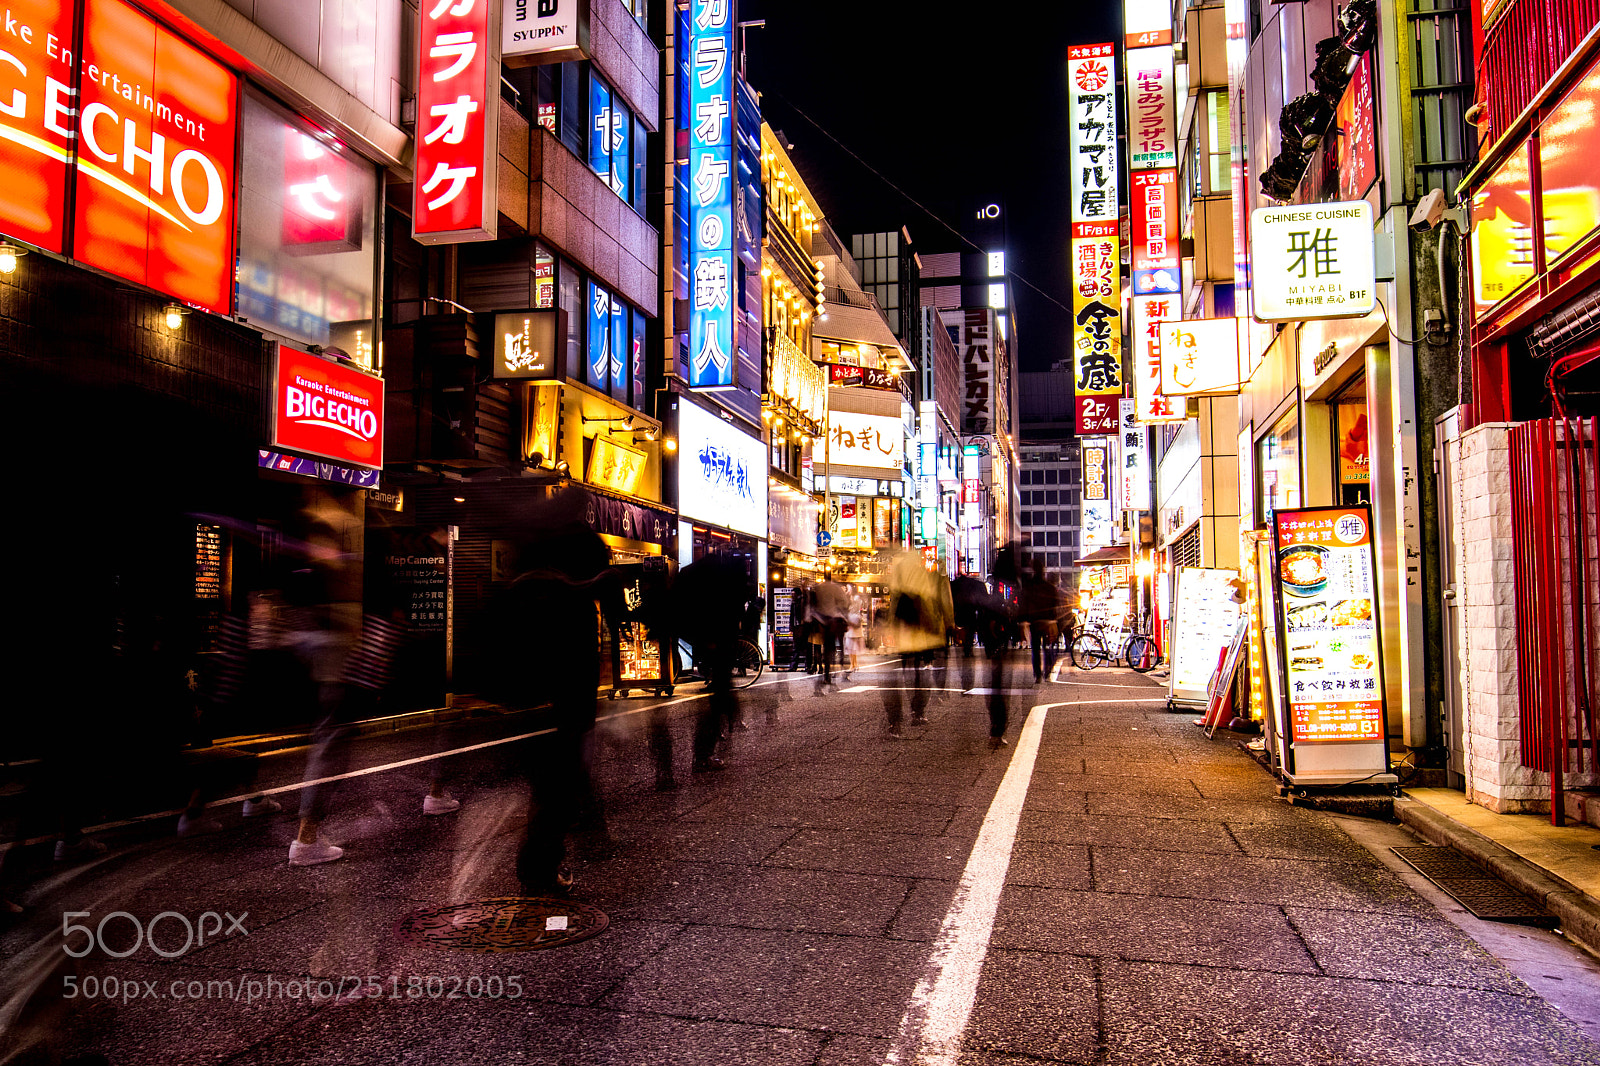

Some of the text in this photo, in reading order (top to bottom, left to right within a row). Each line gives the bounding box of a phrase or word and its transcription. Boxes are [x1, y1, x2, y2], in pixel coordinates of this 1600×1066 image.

[1138, 32, 1159, 45] 4F
[1071, 45, 1112, 57] 大衆酒場
[44, 75, 224, 226] ECHO
[1077, 94, 1108, 217] アカマル屋
[1264, 208, 1361, 224] CHINESE CUISINE
[1077, 224, 1115, 236] 1F/B1F
[1079, 244, 1097, 278] 酒場
[1286, 228, 1341, 279] 雅
[1100, 242, 1114, 296] きんくら
[1289, 284, 1342, 295] MIYABI
[1349, 290, 1367, 299] B1F
[1286, 295, 1346, 306] 中華料理 点心
[1077, 300, 1120, 391] 金の蔵
[1168, 328, 1198, 388] ねぎし
[296, 375, 369, 407] Karaoke Entertainment
[286, 385, 377, 439] BIG ECHO
[1082, 417, 1119, 430] 3F/4F
[831, 423, 893, 456] ねぎし
[1087, 449, 1104, 498] 時計館
[369, 489, 401, 504] Camera
[1340, 518, 1362, 537] 雅
[386, 555, 445, 567] Map Camera
[1294, 678, 1375, 692] 食べ飲み放題
[1360, 720, 1379, 733] B1
